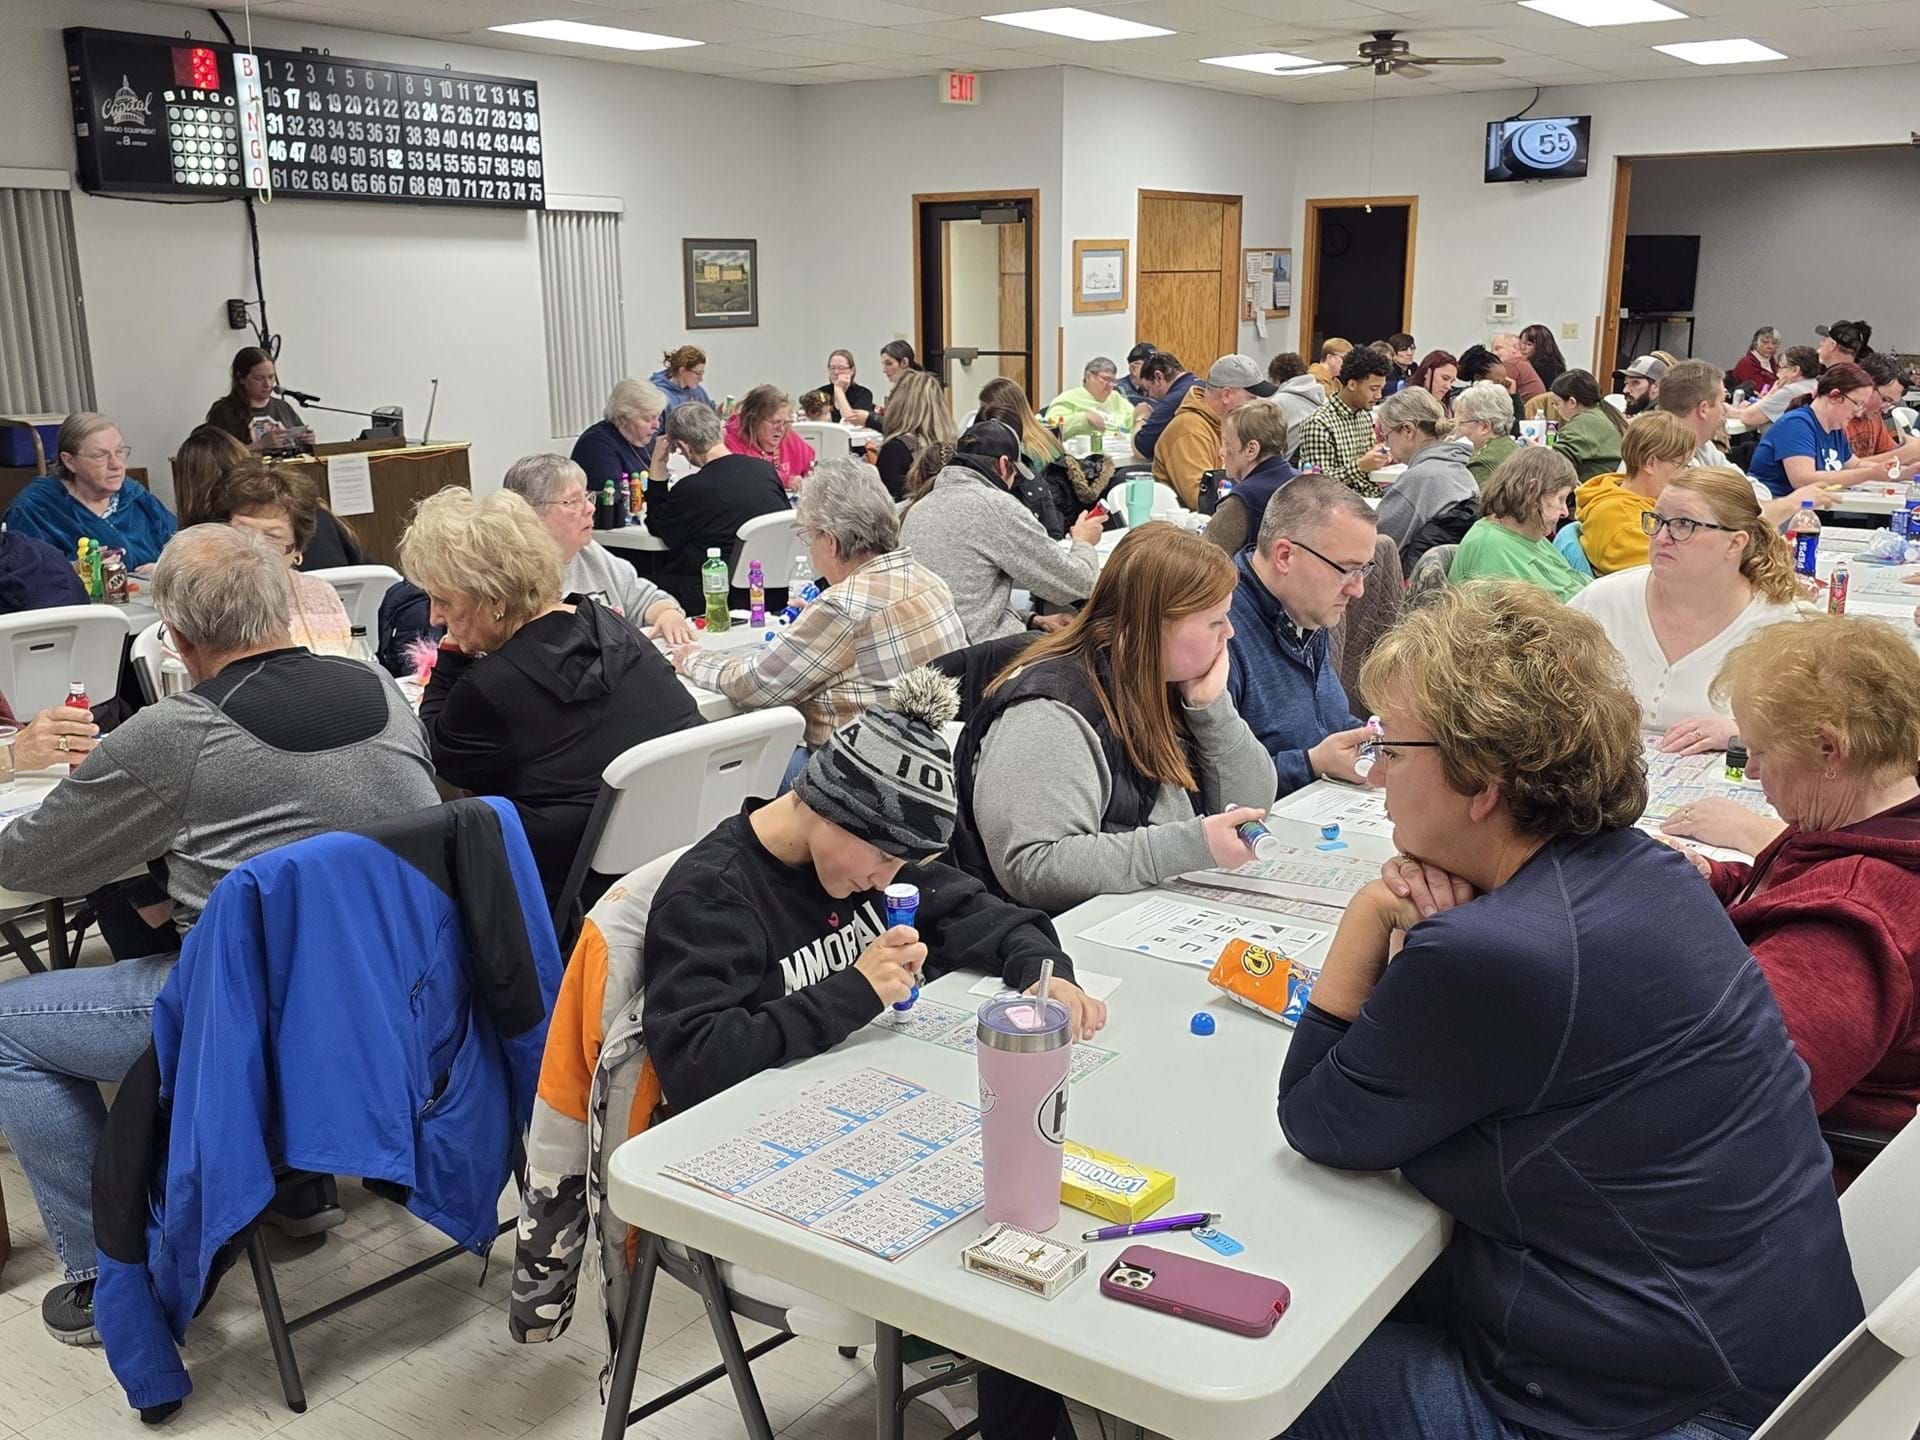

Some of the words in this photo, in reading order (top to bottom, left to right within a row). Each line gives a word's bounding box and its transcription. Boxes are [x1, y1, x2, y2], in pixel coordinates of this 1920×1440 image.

[264, 61, 272, 79] 1
[285, 63, 295, 82] 2
[306, 65, 315, 83] 3
[327, 67, 335, 85] 4
[345, 70, 355, 88] 5
[365, 72, 374, 89] 6
[384, 74, 392, 91] 7
[405, 77, 414, 94] 8
[424, 79, 432, 96] 9
[439, 81, 452, 98] 10
[457, 83, 470, 100] 11
[473, 85, 487, 102] 12
[491, 87, 503, 104] 13
[507, 89, 519, 106] 14
[523, 90, 535, 107] 15
[950, 74, 976, 101] EXIT
[102, 92, 153, 120] Capital
[264, 87, 280, 107] 16
[284, 88, 300, 109] 17
[306, 92, 322, 111] 18
[327, 94, 341, 112] 19
[345, 95, 361, 114] 20
[365, 97, 380, 116] 21
[383, 99, 399, 118] 22
[404, 101, 419, 120] 23
[423, 102, 438, 121] 24
[440, 105, 455, 123] 25
[457, 106, 472, 125] 26
[475, 108, 489, 126] 27
[492, 110, 506, 128] 28
[508, 112, 522, 130] 29
[524, 113, 538, 131] 30
[267, 113, 283, 134] 31
[287, 116, 304, 136] 32
[308, 118, 325, 137] 33
[328, 120, 344, 139] 34
[347, 122, 364, 140] 35
[367, 123, 383, 142] 36
[385, 125, 400, 144] 37
[406, 126, 422, 145] 38
[424, 128, 440, 147] 39
[442, 130, 457, 148] 40
[460, 131, 475, 149] 41
[477, 133, 491, 151] 42
[494, 134, 508, 152] 43
[510, 136, 524, 153] 44
[526, 136, 540, 155] 45
[1539, 133, 1570, 155] 55
[269, 140, 287, 161] 46
[289, 142, 306, 162] 47
[310, 144, 327, 163] 48
[330, 146, 346, 165] 49
[350, 147, 366, 166] 50
[370, 149, 384, 167] 51
[387, 149, 403, 169] 52
[408, 151, 423, 170] 53
[426, 153, 441, 171] 54
[444, 154, 459, 172] 55
[461, 156, 476, 174] 56
[478, 157, 493, 175] 57
[495, 158, 509, 176] 58
[511, 159, 524, 177] 59
[527, 160, 541, 178] 60
[272, 169, 287, 187] 61
[292, 170, 309, 189] 62
[312, 171, 328, 190] 63
[332, 172, 348, 191] 64
[351, 174, 368, 192] 65
[371, 175, 386, 193] 66
[389, 175, 404, 194] 67
[410, 177, 425, 195] 68
[428, 178, 443, 196] 69
[445, 179, 460, 197] 70
[463, 180, 476, 197] 71
[479, 181, 494, 198] 72
[496, 182, 510, 199] 73
[513, 183, 526, 200] 74
[529, 184, 542, 201] 75
[1797, 541, 1808, 569] PEPSI
